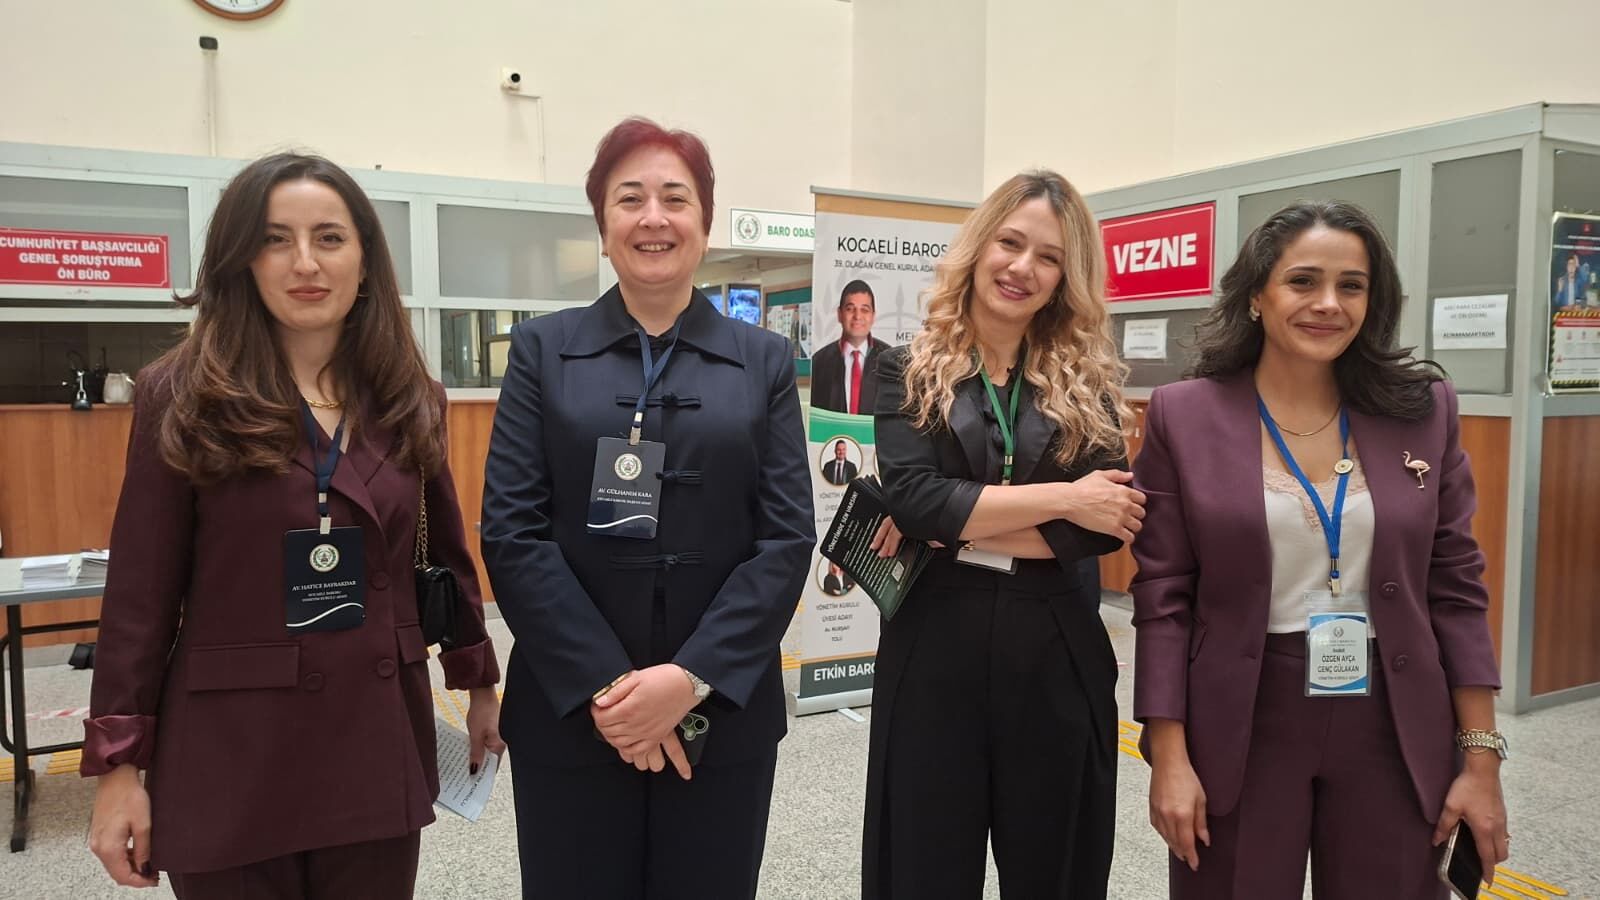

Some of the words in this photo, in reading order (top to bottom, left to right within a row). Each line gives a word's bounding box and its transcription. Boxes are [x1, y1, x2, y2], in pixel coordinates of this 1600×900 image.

[767, 225, 791, 237] BARO
[0, 236, 78, 250] CUMHURİYET
[81, 240, 160, 254] BAŞSAVCILIĞI
[837, 236, 898, 255] KOCAELİ
[19, 252, 59, 264] GENEL
[62, 254, 142, 268] SORUŞTURMA
[1112, 232, 1198, 275] VEZNE
[835, 259, 843, 267] 39.
[845, 259, 873, 269] OLAĞAN
[875, 261, 896, 271] GENEL
[897, 263, 919, 272] KURUL
[57, 267, 75, 279] ÖN
[78, 268, 110, 280] BÜRO
[1322, 653, 1340, 663] ÖZGEN
[1341, 655, 1356, 663] AYÇA
[814, 663, 846, 681] ETKİN
[1317, 665, 1333, 674] GENÇ
[1334, 664, 1360, 673] GÜLAKAN
